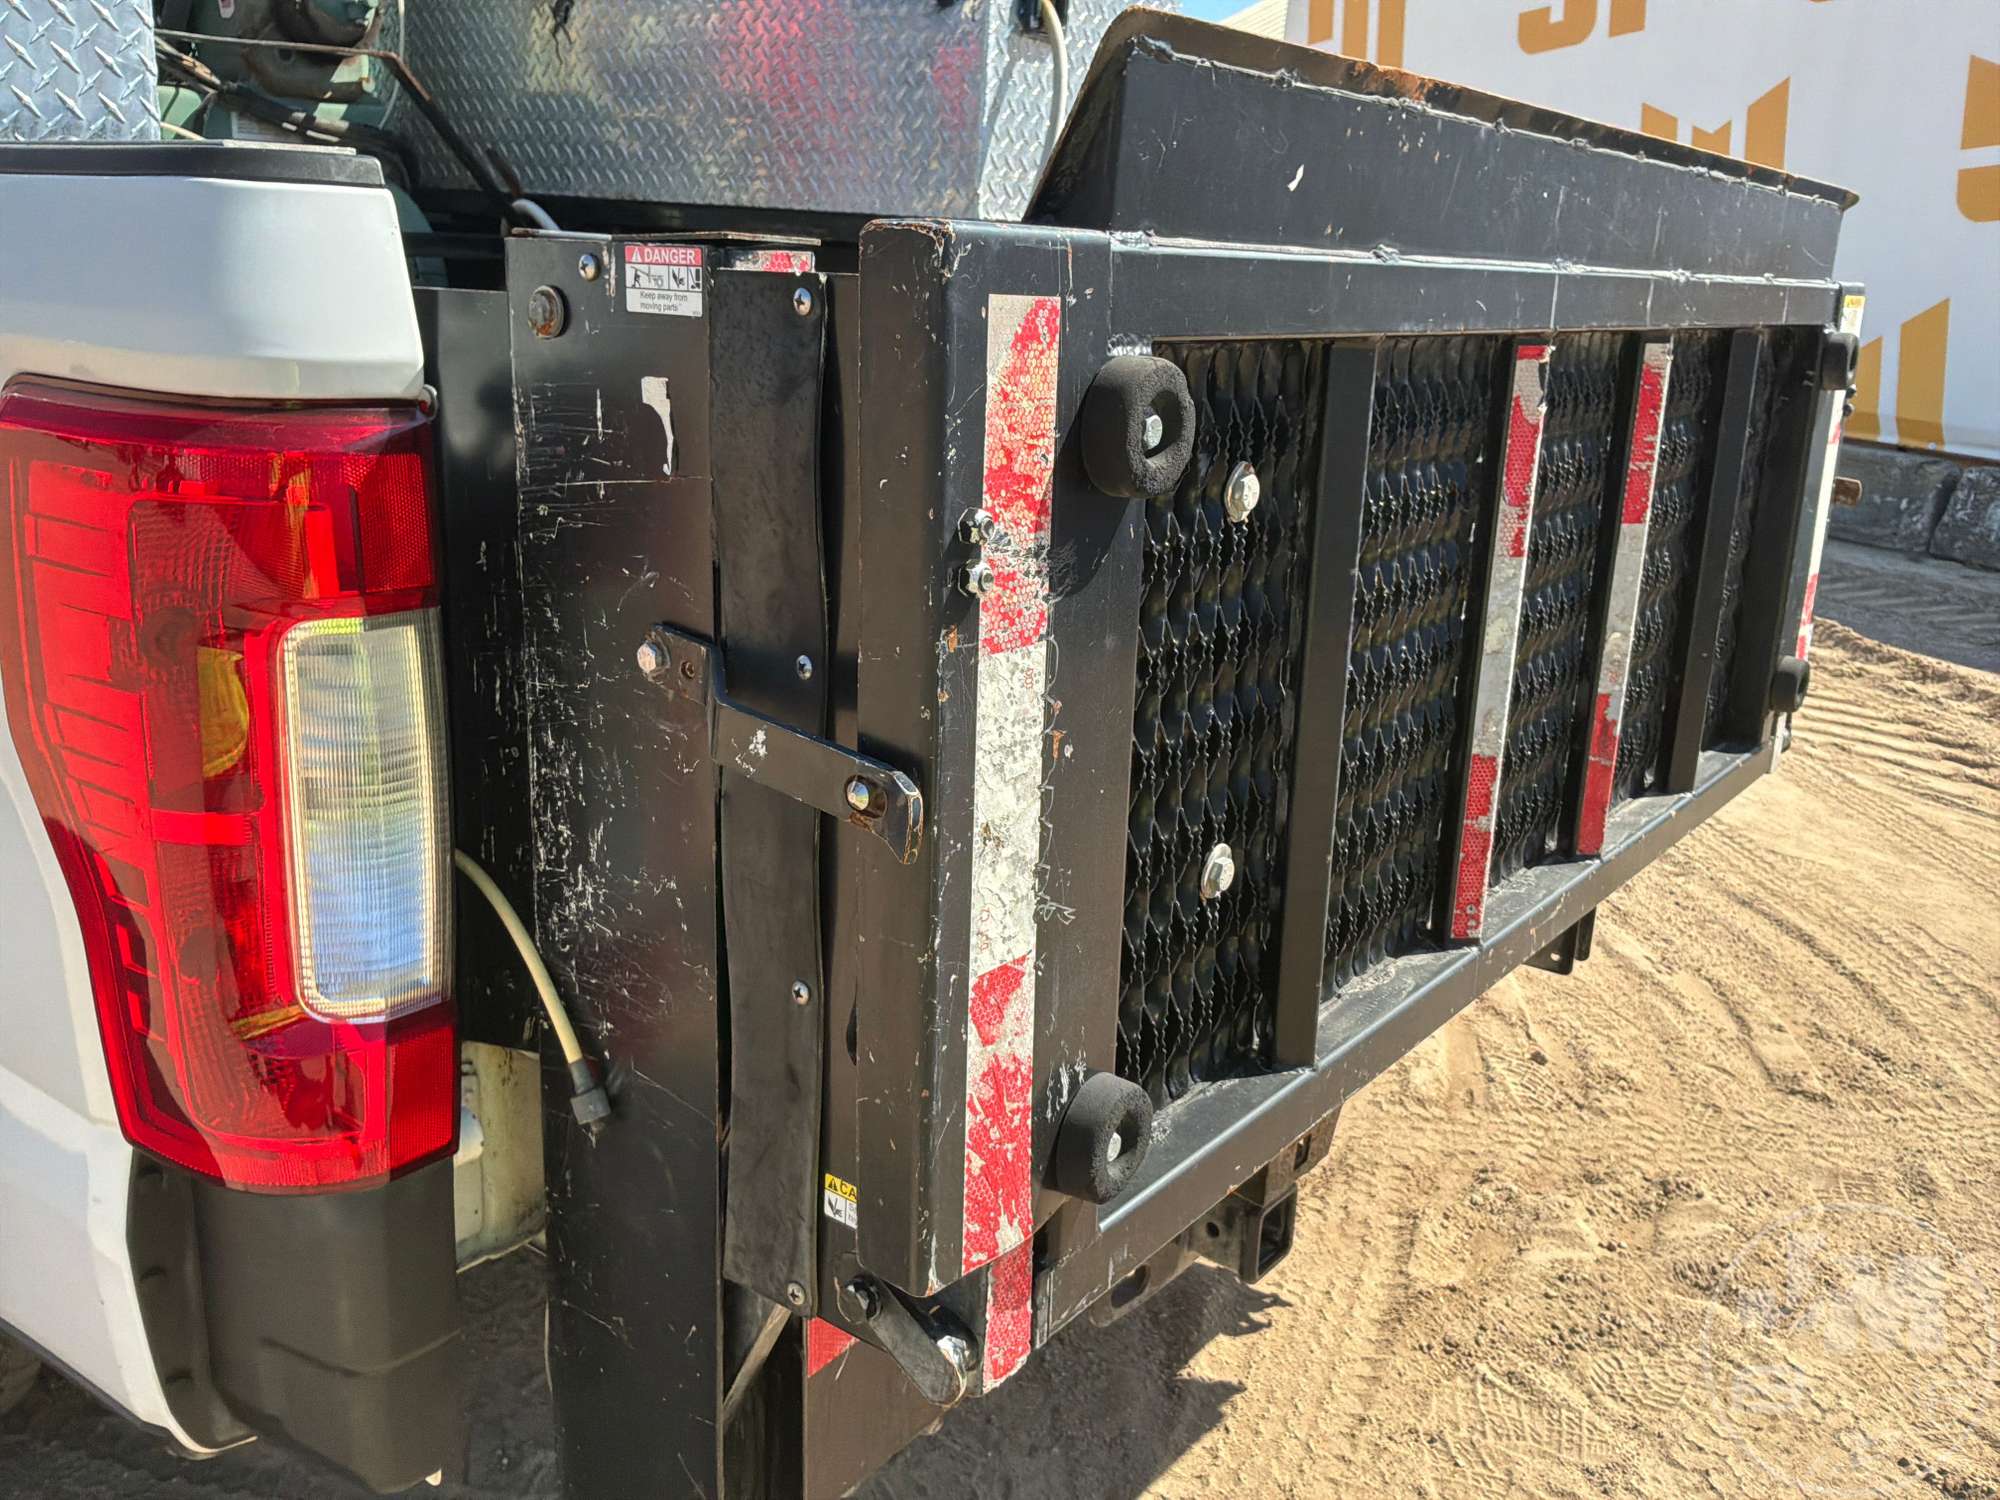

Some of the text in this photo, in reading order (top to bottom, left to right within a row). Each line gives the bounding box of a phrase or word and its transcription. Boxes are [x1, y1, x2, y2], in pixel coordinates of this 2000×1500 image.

[644, 247, 696, 264] DANGER
[640, 291, 688, 303] Keep away from
[640, 302, 678, 312] moving parts
